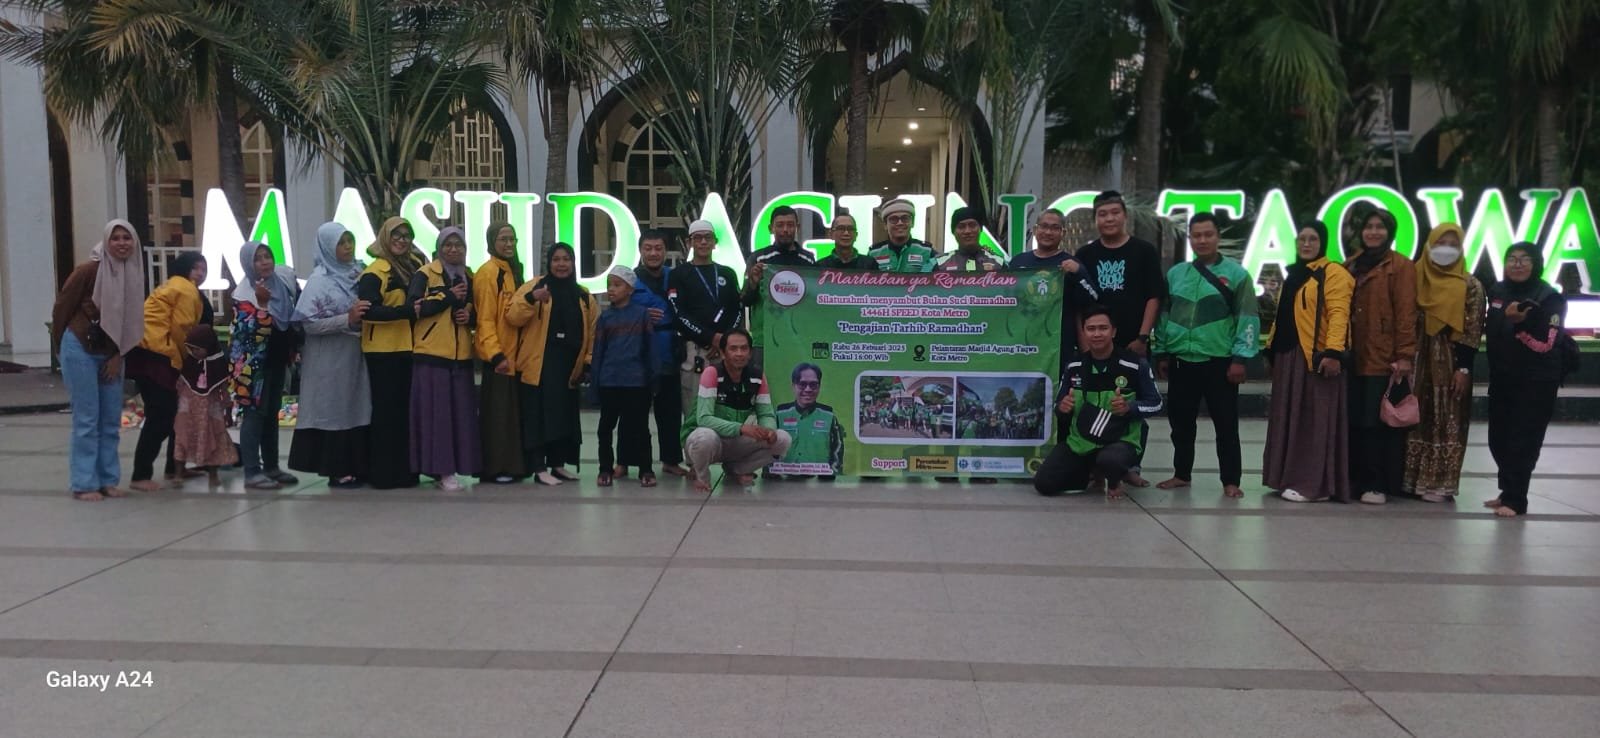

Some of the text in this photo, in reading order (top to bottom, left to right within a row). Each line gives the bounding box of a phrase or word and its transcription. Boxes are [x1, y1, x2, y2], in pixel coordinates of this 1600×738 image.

[818, 270, 1017, 293] Marhaban ya Ramadhan
[818, 295, 1016, 306] Silaturahmi menyambut Bulan Suci Ramadhan
[862, 308, 969, 317] 1446H SPEED Kota Metro
[892, 323, 926, 333] Tarhib
[992, 345, 1015, 354] Agung
[1016, 345, 1037, 354] Taqwa
[833, 353, 853, 361] Pukul
[872, 459, 906, 468] Support
